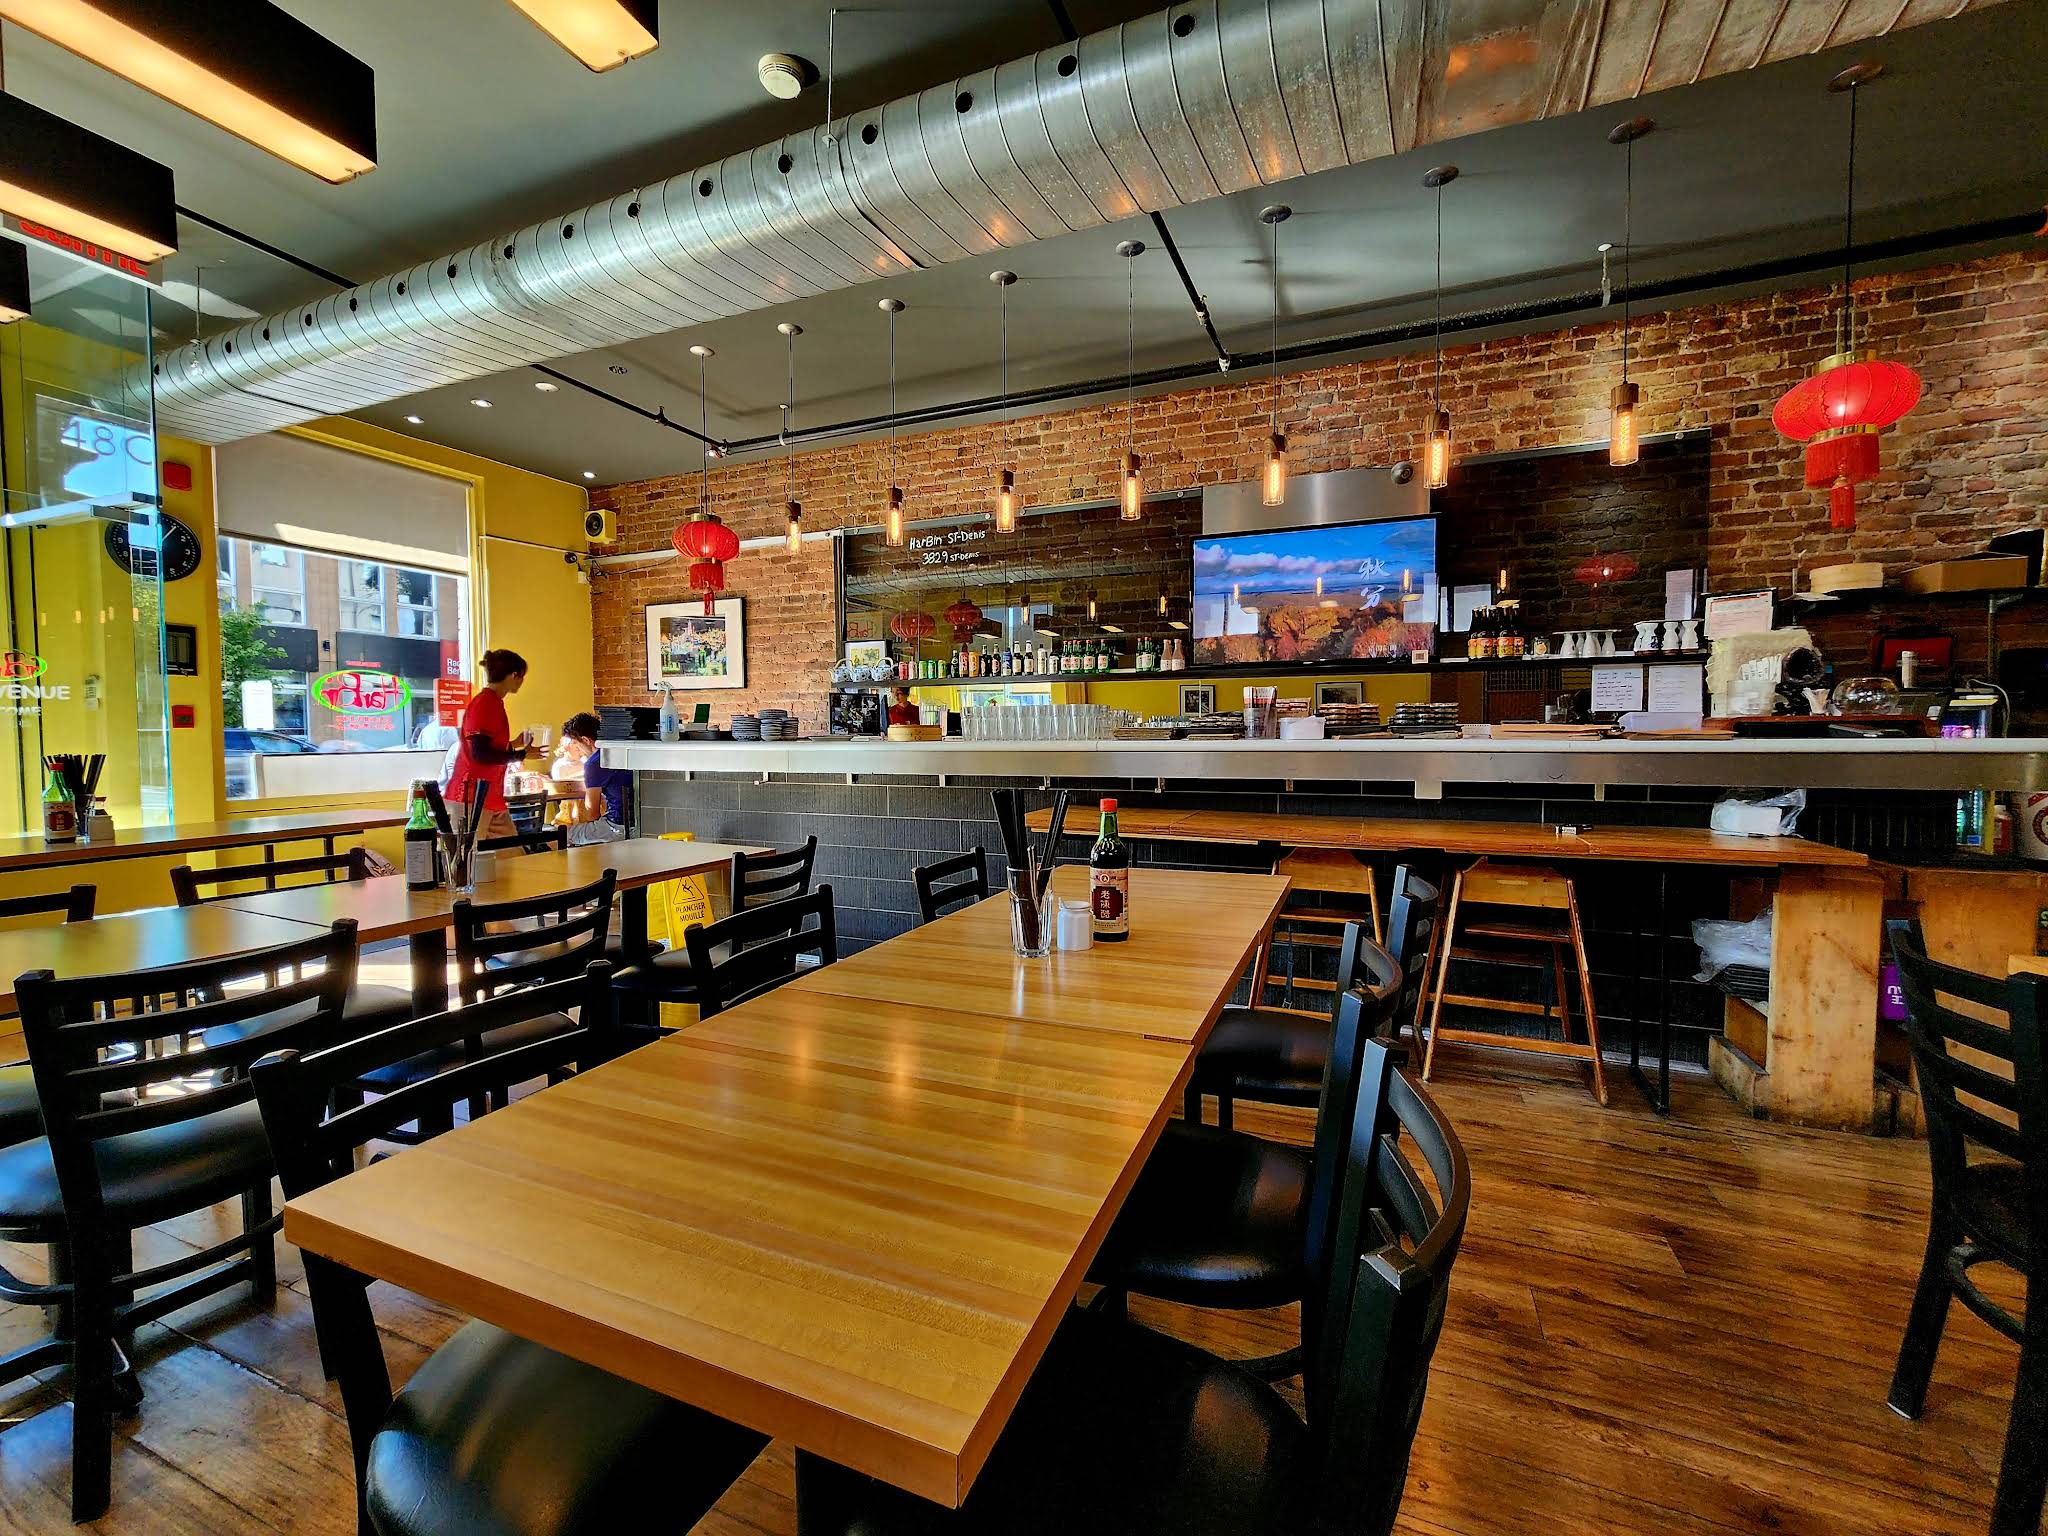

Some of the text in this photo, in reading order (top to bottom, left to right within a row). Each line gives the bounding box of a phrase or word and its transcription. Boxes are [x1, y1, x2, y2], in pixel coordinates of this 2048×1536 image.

[909, 535, 943, 551] HarBin
[922, 551, 948, 565] 3829
[676, 902, 706, 913] PLANCHER
